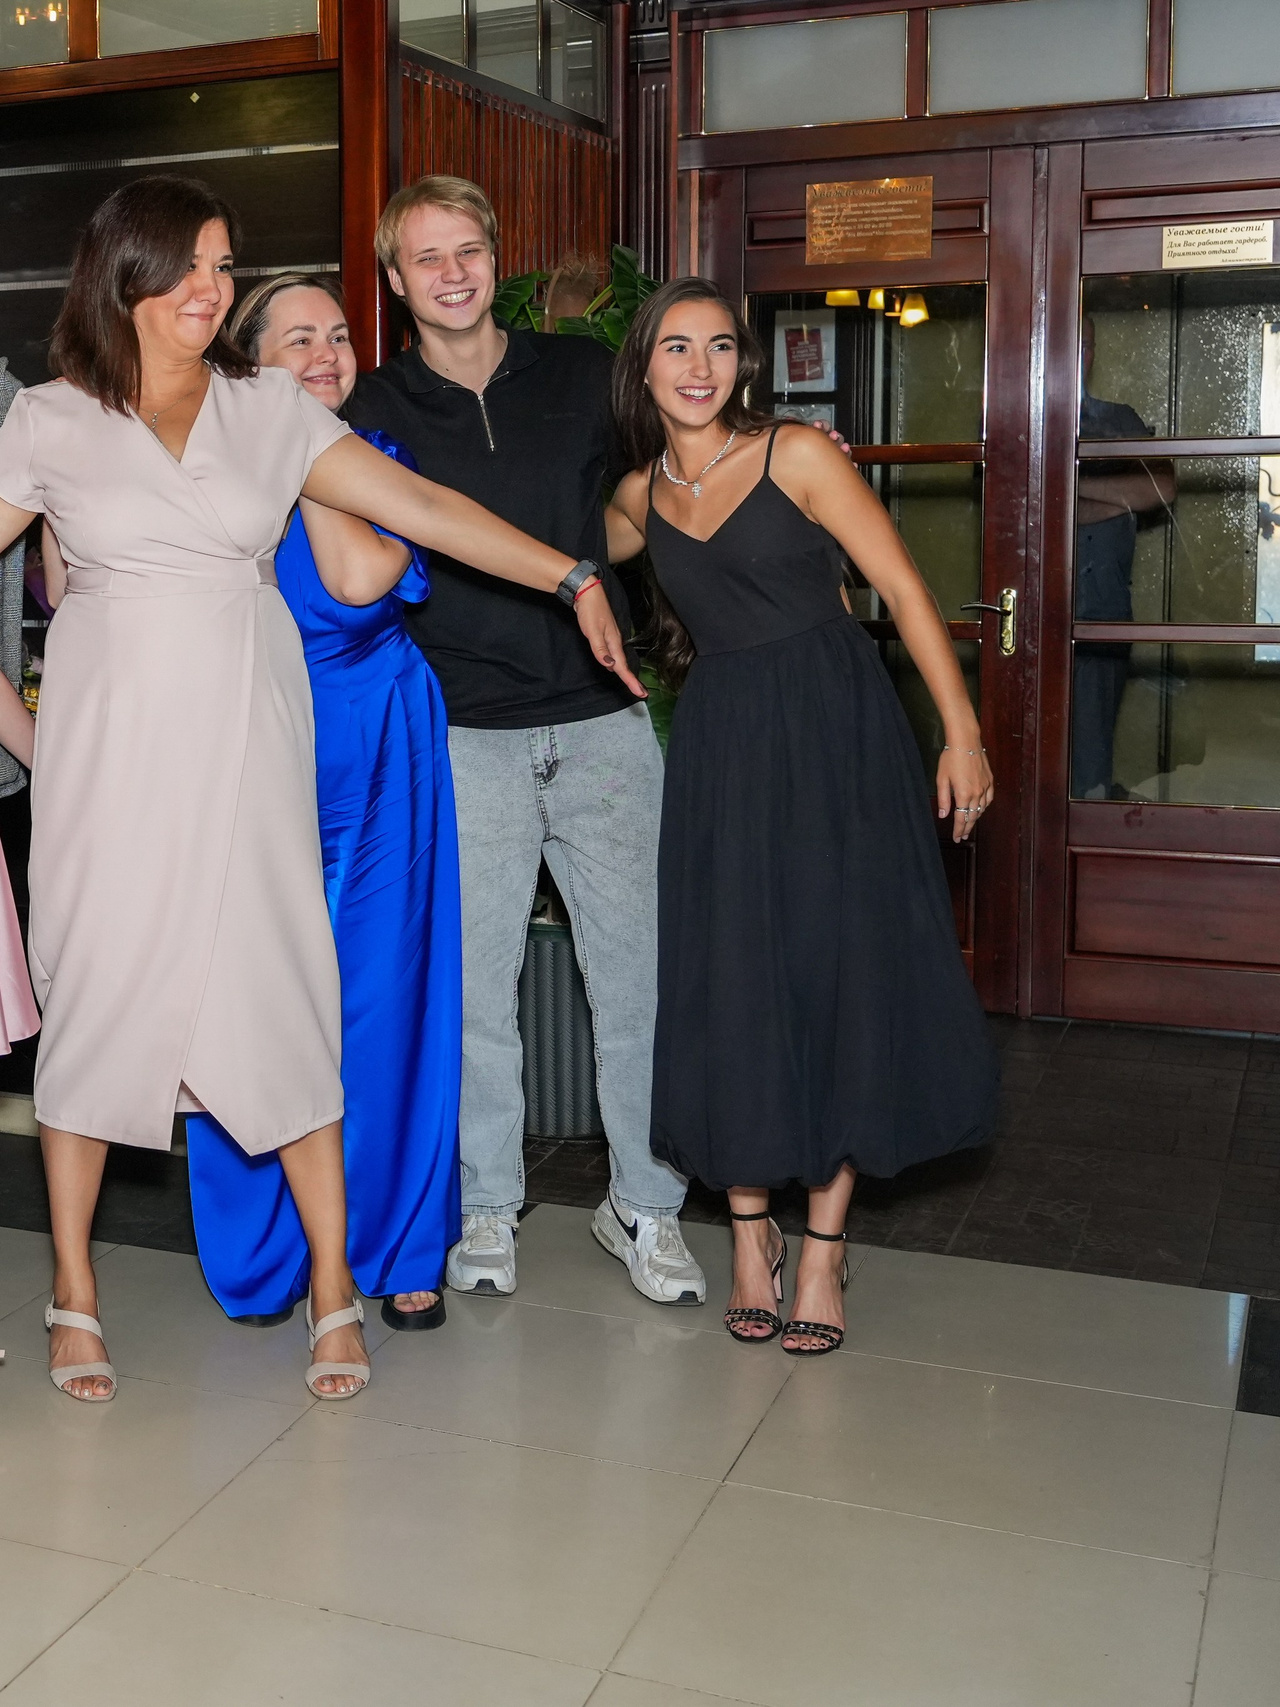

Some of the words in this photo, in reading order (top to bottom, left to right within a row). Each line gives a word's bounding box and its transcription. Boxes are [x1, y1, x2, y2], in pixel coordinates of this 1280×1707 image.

[812, 186, 884, 199] Уважаемые
[1167, 227, 1228, 237] Уважаемые
[1230, 223, 1265, 233] гости!
[1166, 241, 1181, 249] Для
[1183, 240, 1196, 248] Вас
[1197, 239, 1233, 248] работает
[1235, 236, 1268, 246] гардероб.
[1167, 250, 1207, 259] Приятного
[1207, 247, 1239, 256] отдыха!
